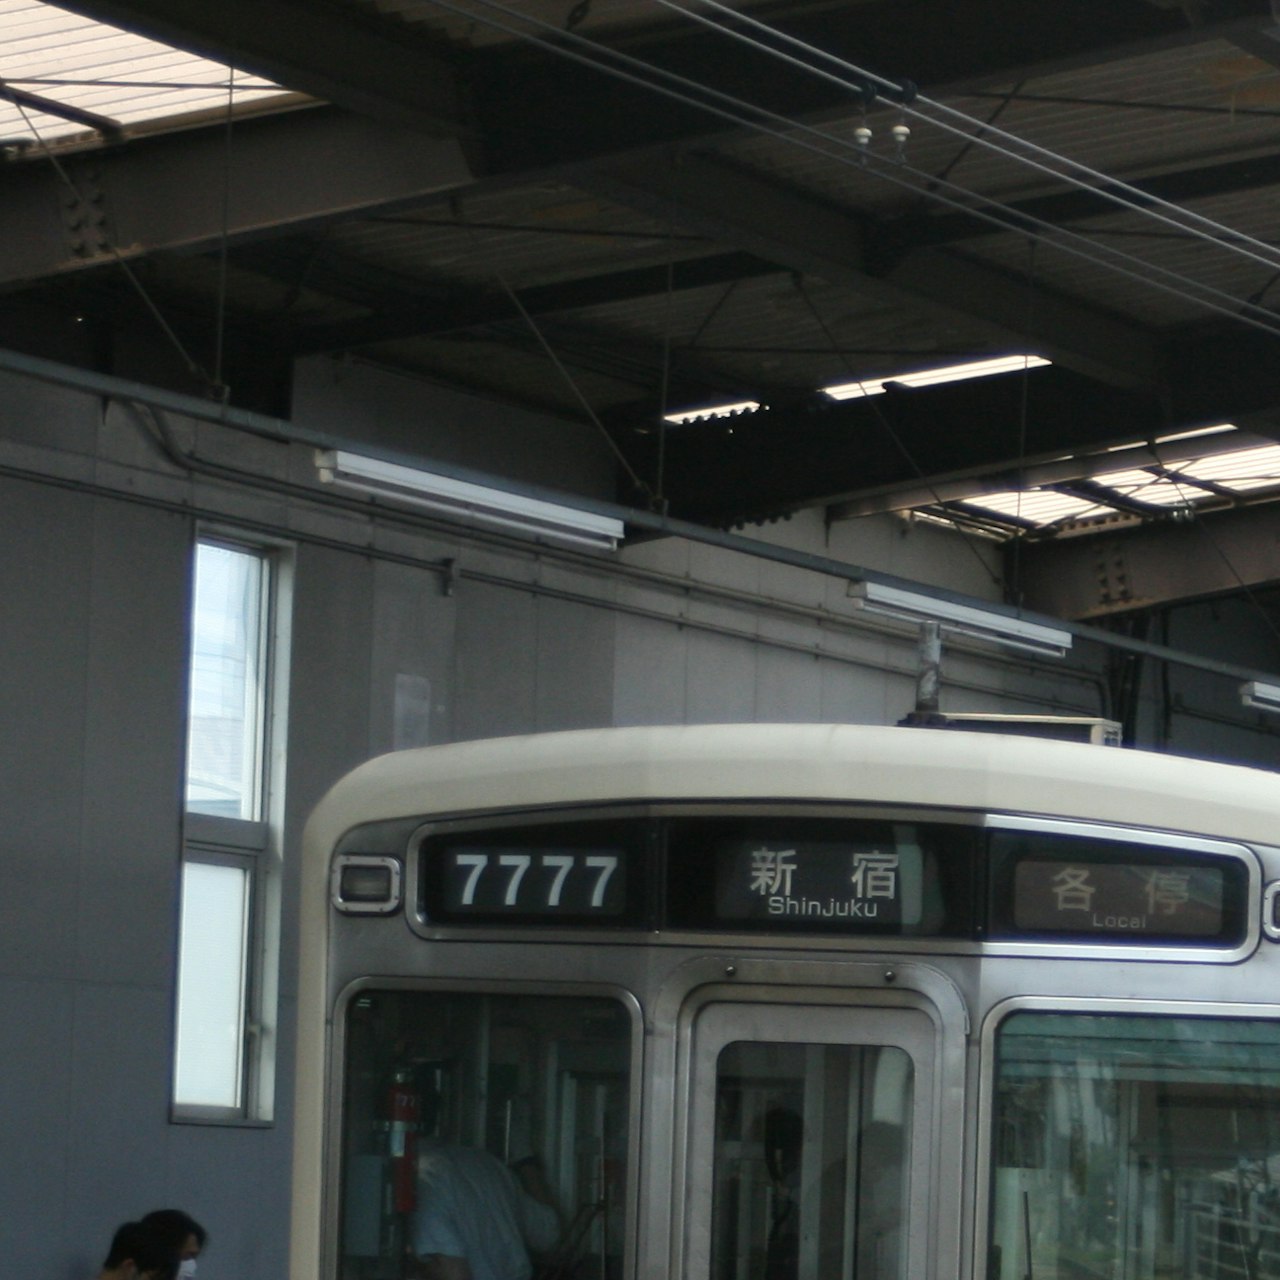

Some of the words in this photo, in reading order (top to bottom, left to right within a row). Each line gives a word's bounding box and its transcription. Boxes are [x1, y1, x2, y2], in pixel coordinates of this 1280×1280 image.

[456, 854, 617, 907] 7777
[750, 847, 899, 899] 新宿
[1092, 914, 1147, 929] Local
